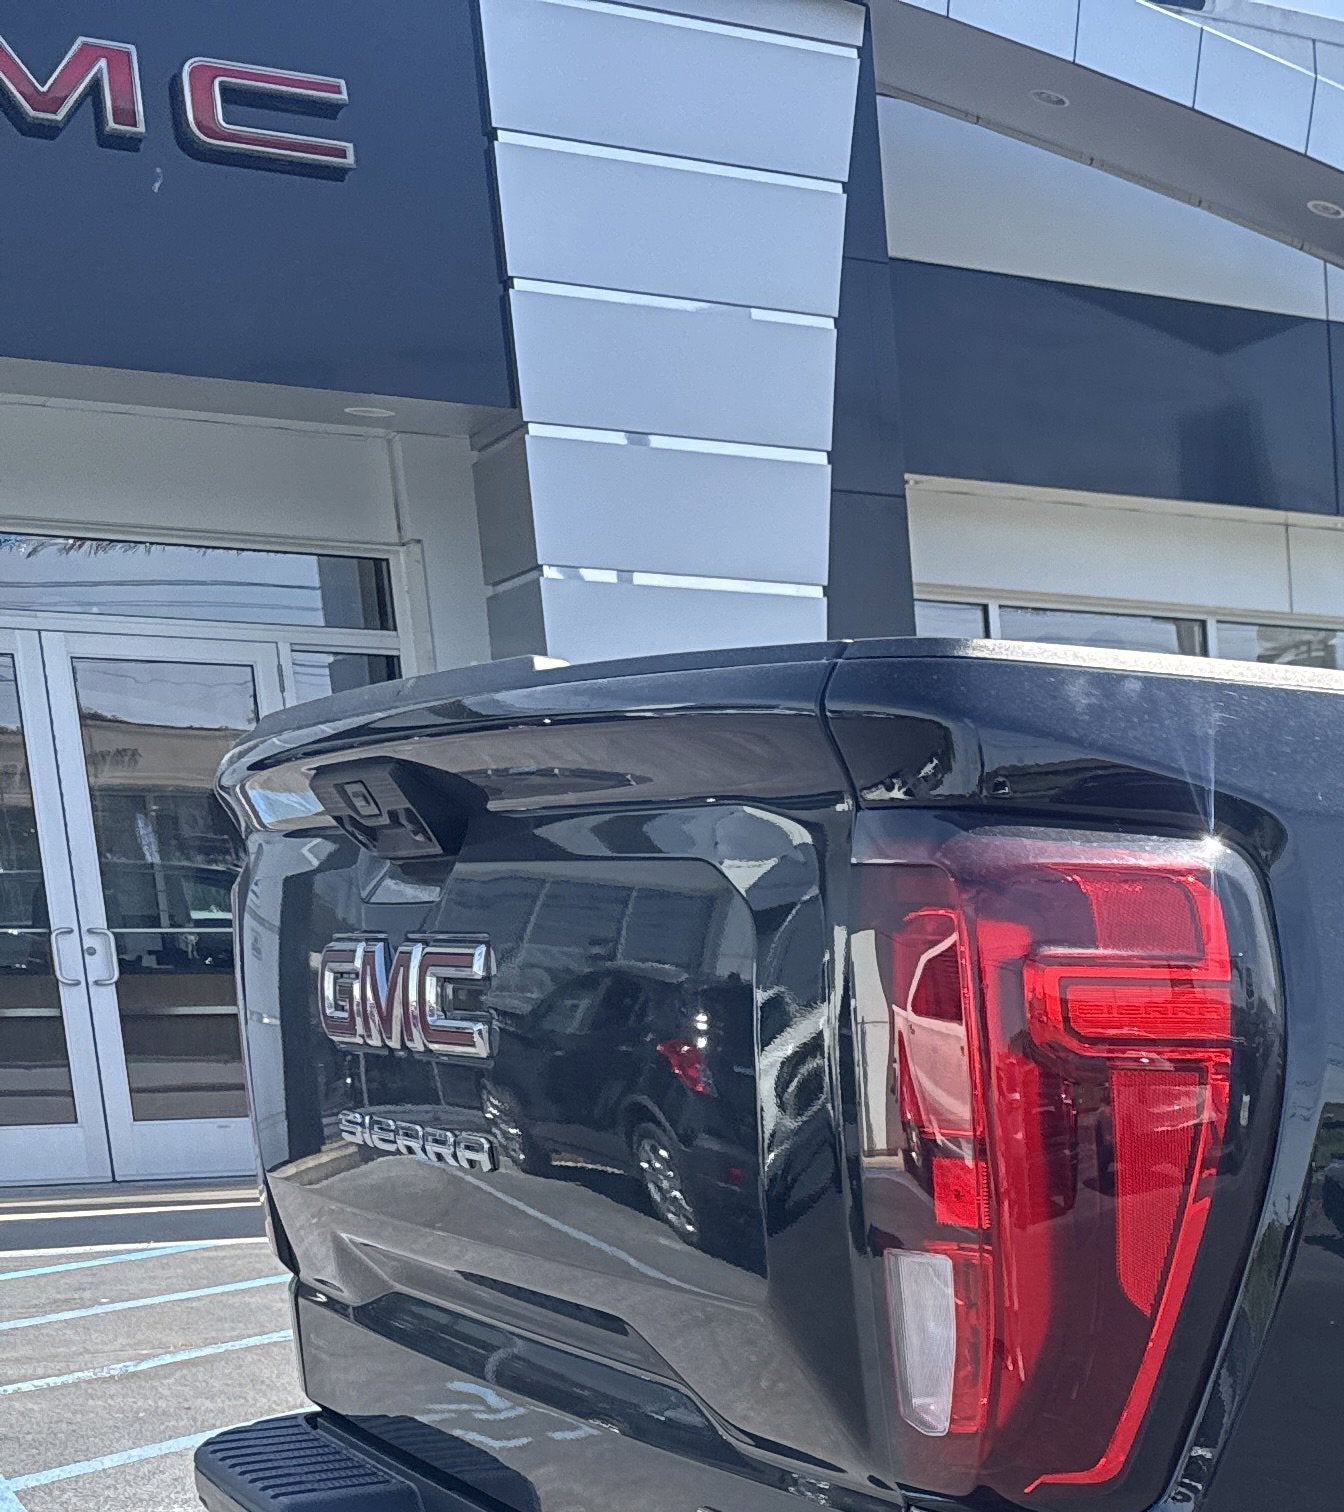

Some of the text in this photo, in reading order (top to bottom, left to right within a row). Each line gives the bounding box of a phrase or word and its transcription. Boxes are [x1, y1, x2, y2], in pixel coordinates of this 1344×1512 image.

[317, 939, 496, 1059] GMC
[1076, 1002, 1228, 1019] SIERRA
[337, 1109, 500, 1174] SIERRA
